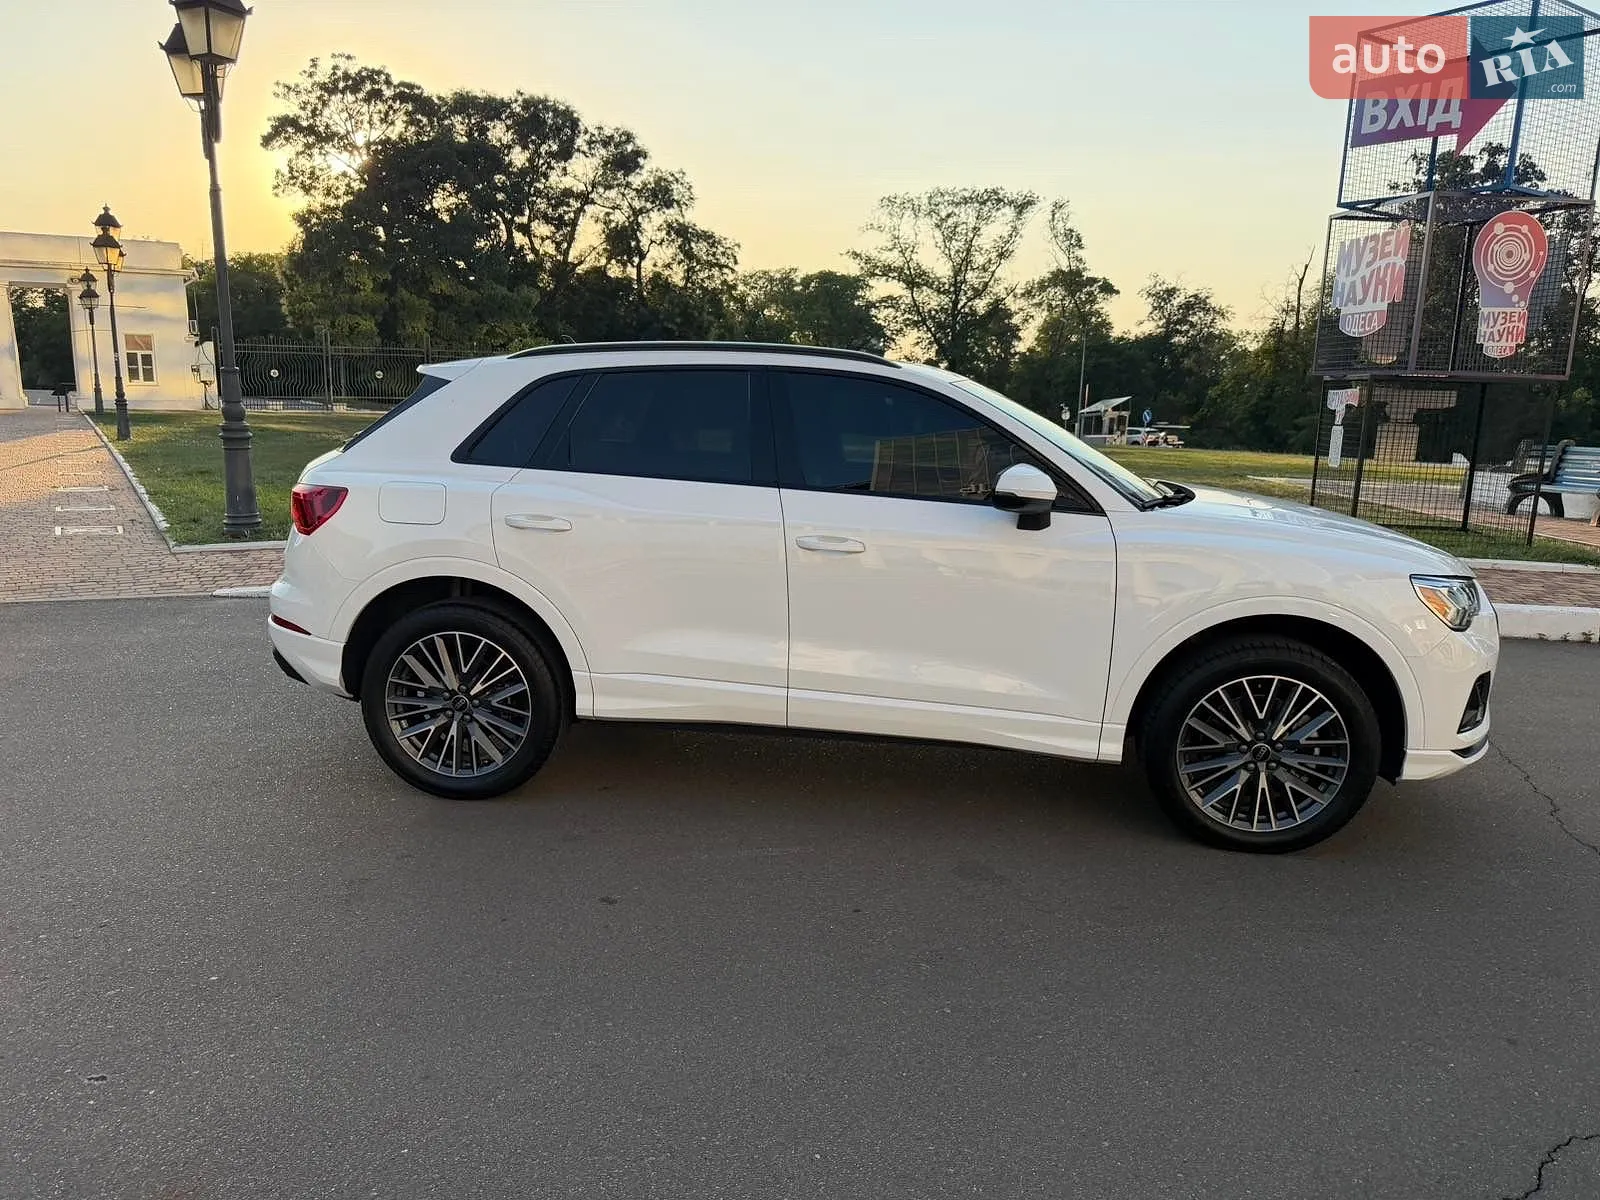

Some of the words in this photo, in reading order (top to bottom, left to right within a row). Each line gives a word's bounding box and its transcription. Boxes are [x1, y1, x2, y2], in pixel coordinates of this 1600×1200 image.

[1360, 77, 1464, 134] ВХІД
[1336, 220, 1410, 279] МУЗЕЙ
[1332, 262, 1405, 308] НАУКИ
[1345, 312, 1378, 335] ОДЕСА
[1477, 325, 1525, 342] НАУКИ
[1480, 309, 1527, 329] МУЗЕЙ
